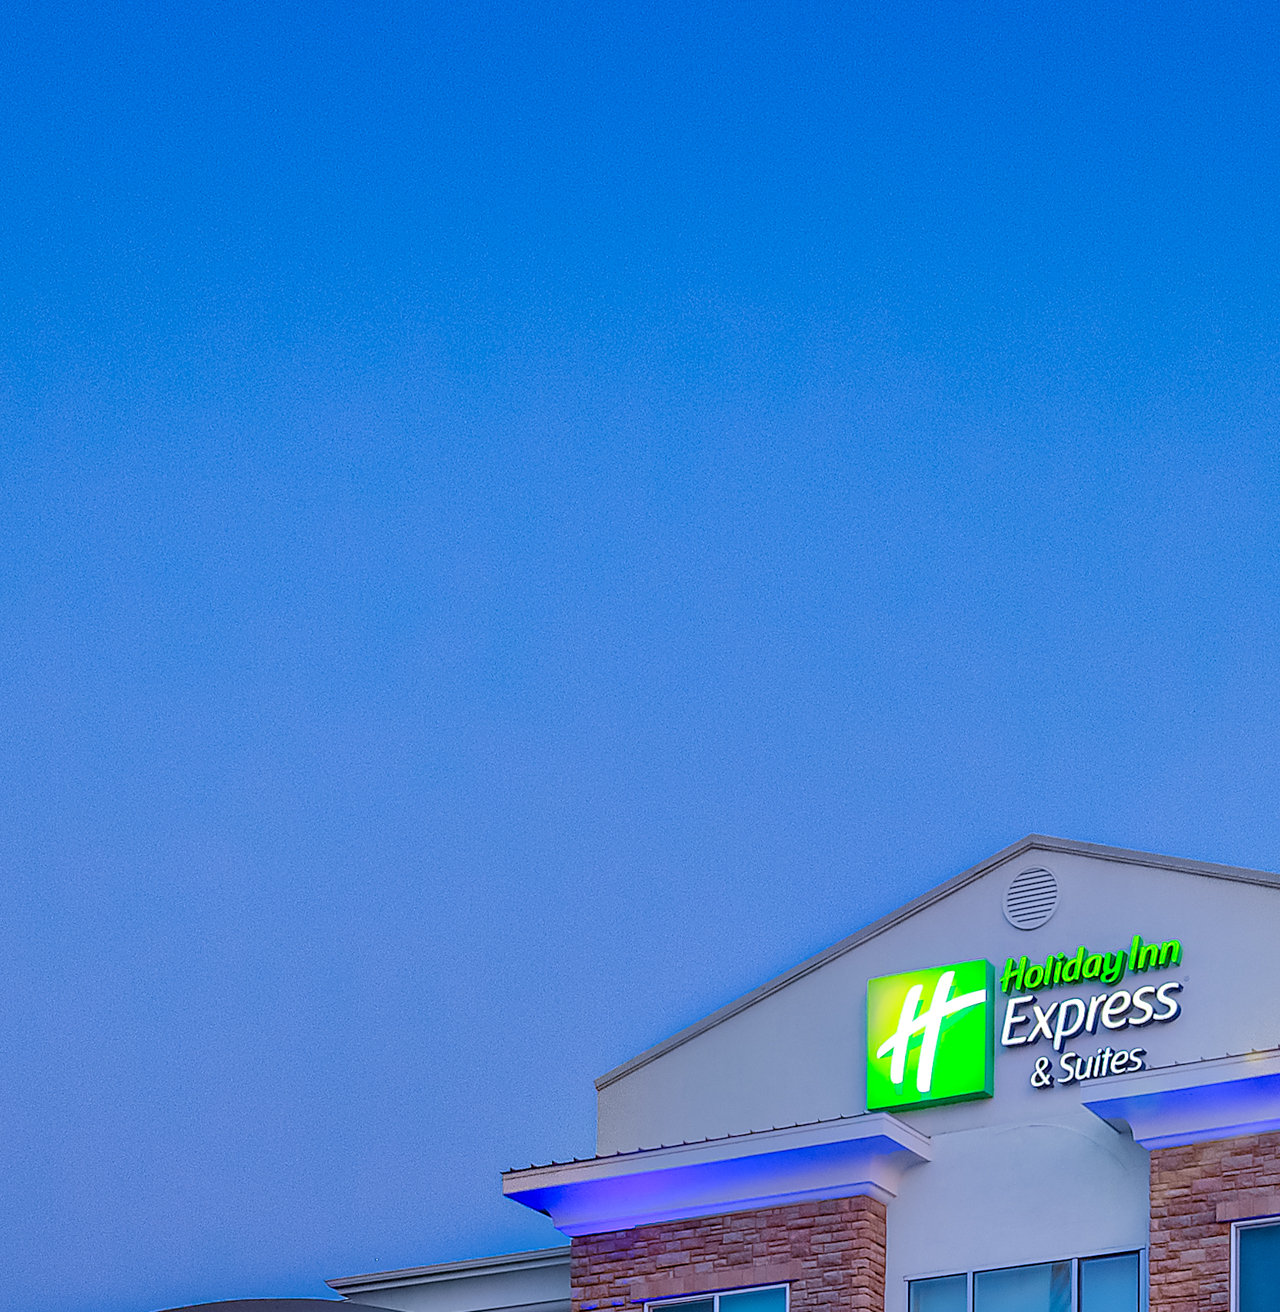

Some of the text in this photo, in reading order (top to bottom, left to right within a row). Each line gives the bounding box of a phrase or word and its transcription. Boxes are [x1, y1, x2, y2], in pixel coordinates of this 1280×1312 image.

[1000, 934, 1183, 995] Holiday Inn
[1000, 982, 1183, 1052] Express
[1030, 1047, 1147, 1088] & Suites
